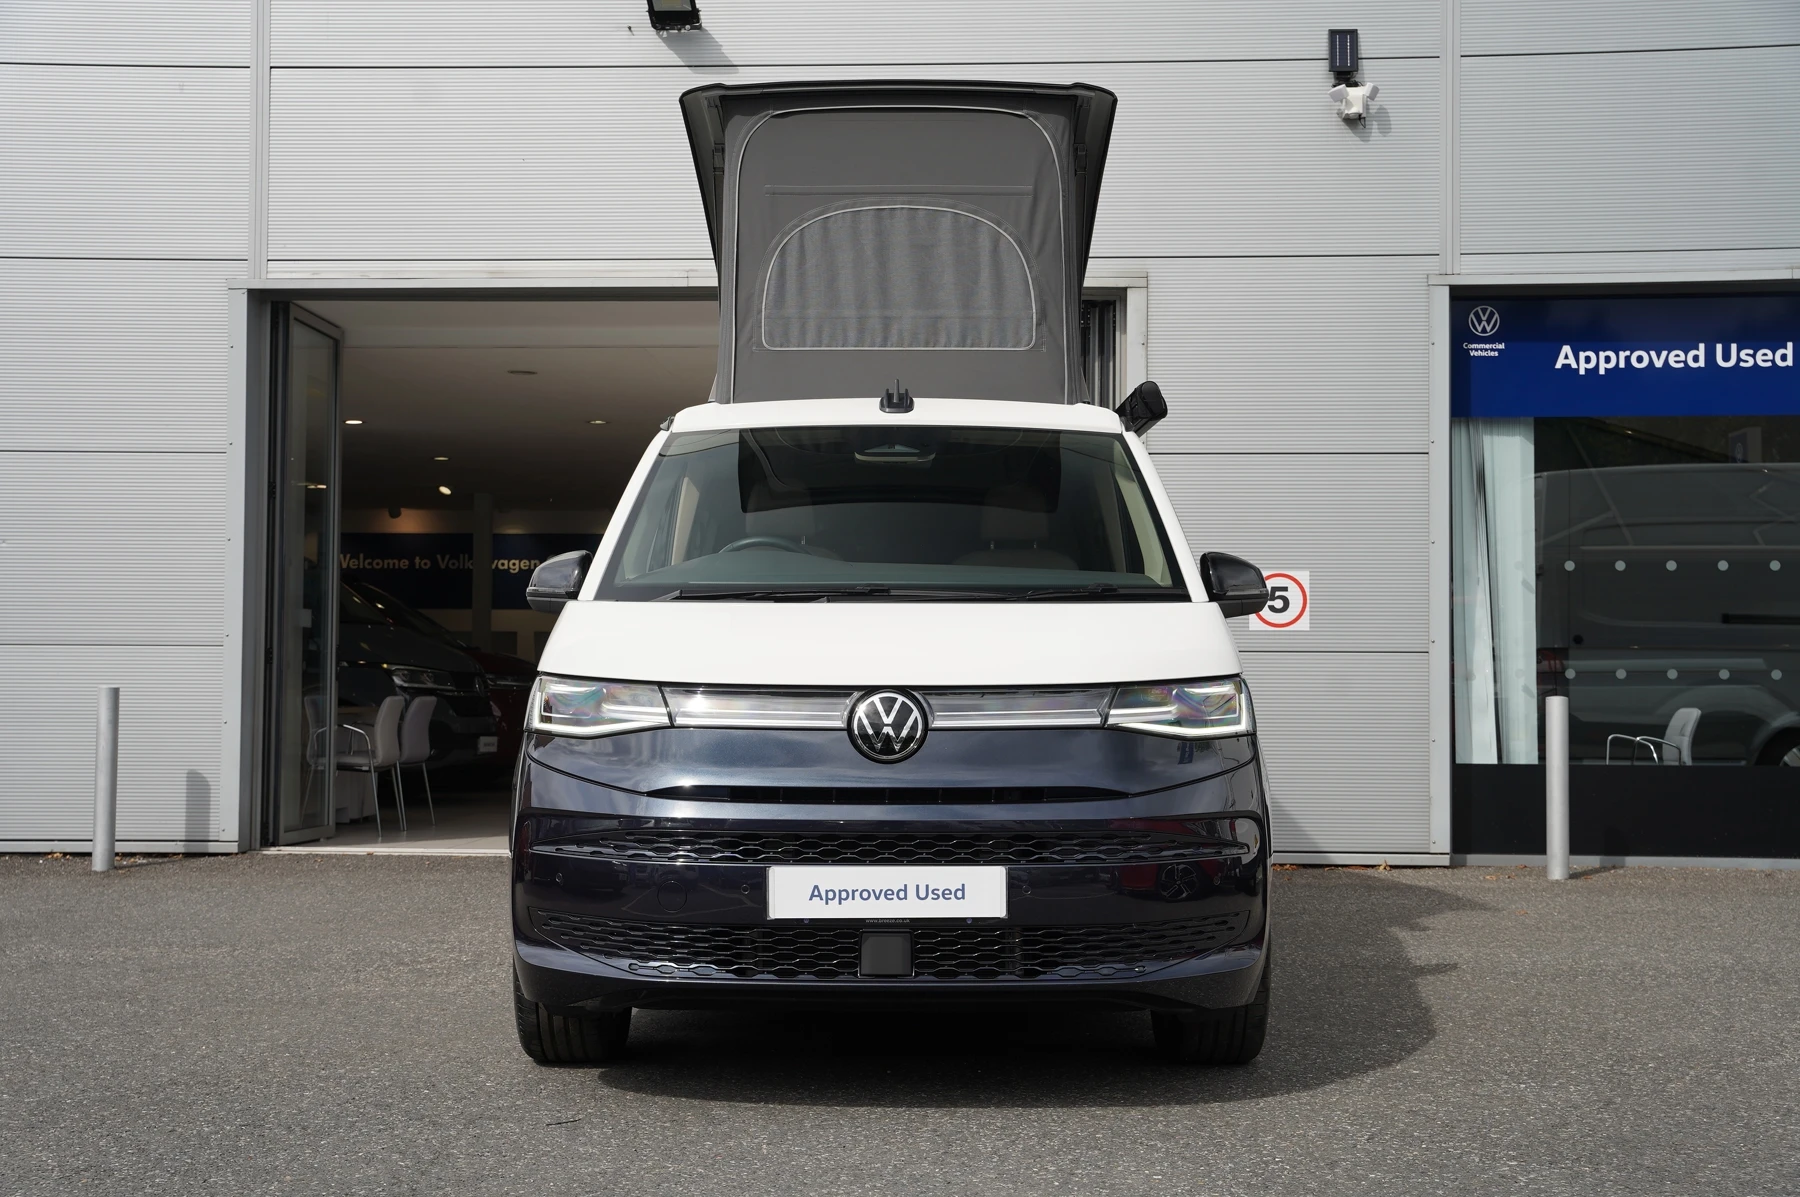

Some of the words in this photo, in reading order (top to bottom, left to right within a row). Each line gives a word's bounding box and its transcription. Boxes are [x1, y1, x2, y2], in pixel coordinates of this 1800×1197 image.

[1554, 343, 1705, 375] Approved
[1715, 341, 1794, 368] Used
[414, 556, 432, 569] to
[436, 554, 540, 574] Volkagen
[1267, 586, 1290, 614] 5
[808, 884, 908, 905] Approved
[915, 883, 966, 901] Used
